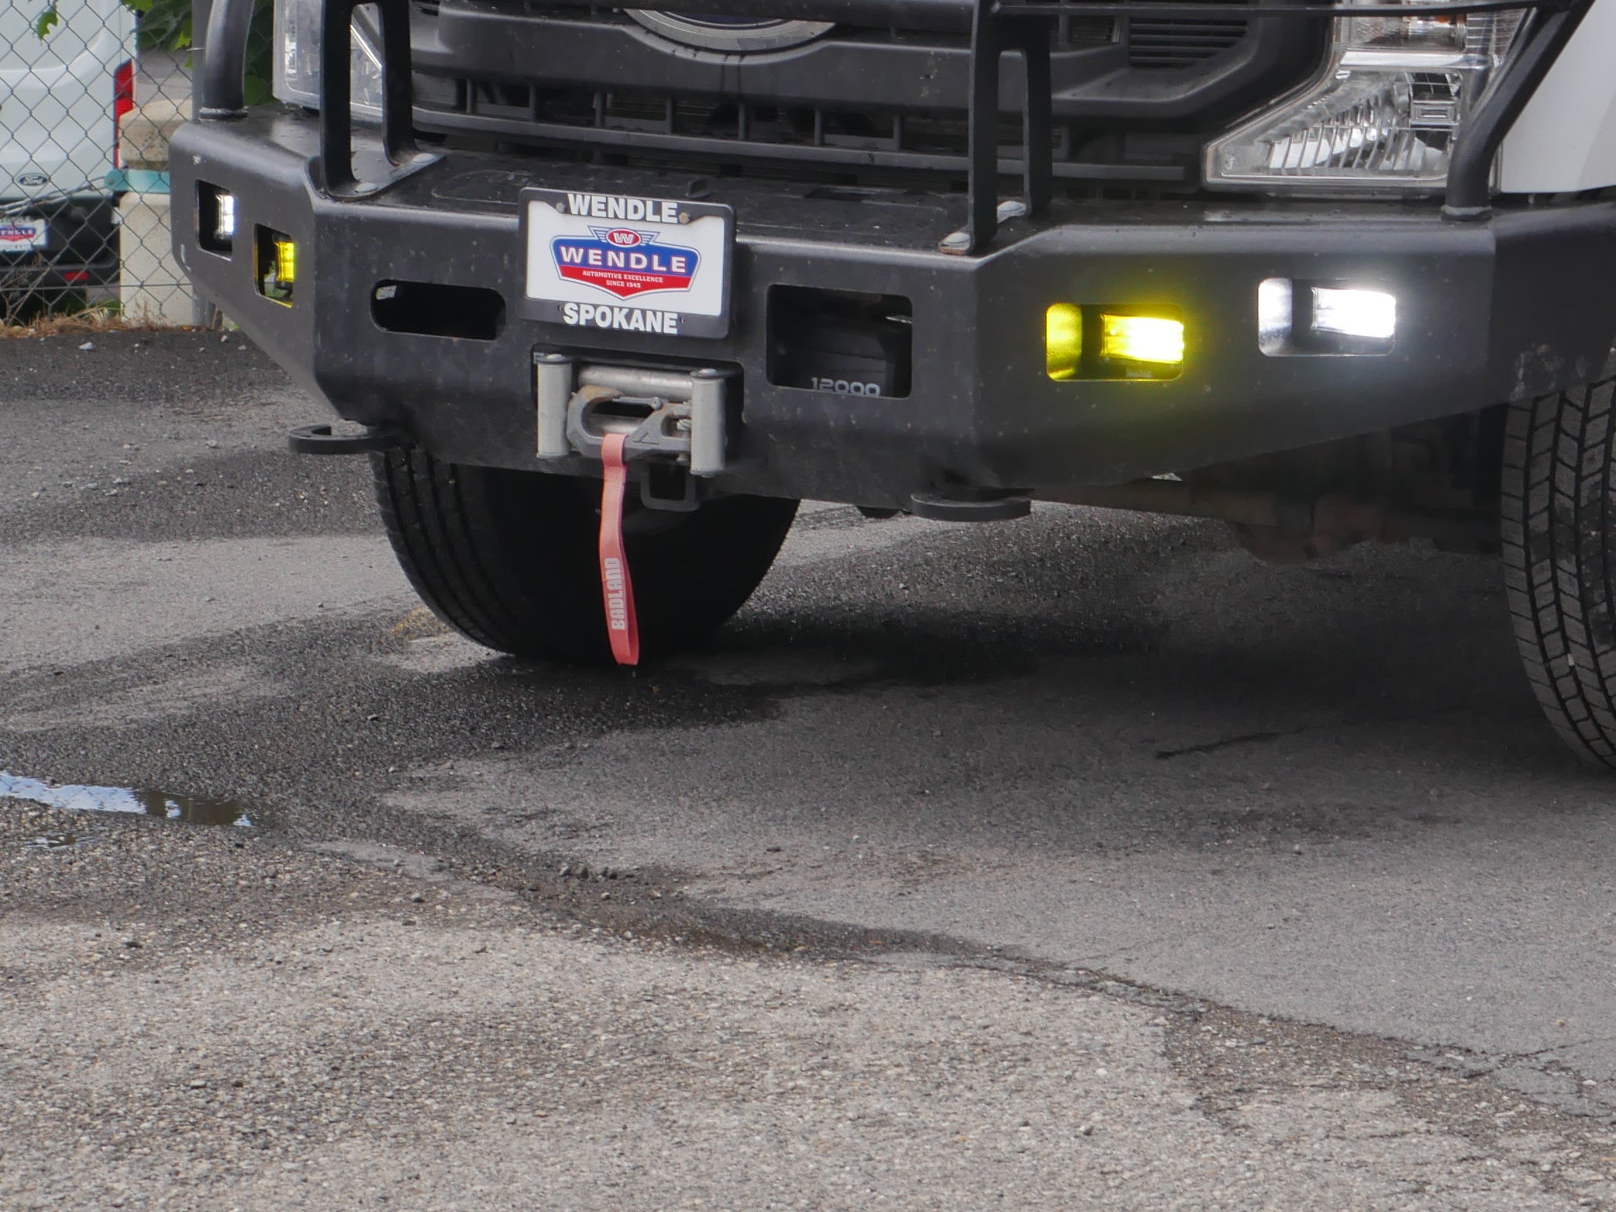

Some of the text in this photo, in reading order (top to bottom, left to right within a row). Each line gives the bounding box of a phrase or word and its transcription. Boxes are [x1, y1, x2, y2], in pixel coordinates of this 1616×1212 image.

[567, 193, 678, 224] WENDLE
[560, 246, 687, 273] WENDLE
[582, 269, 664, 283] AUTOMOTIVE EXCELLENCE
[562, 302, 678, 335] SPOKANE
[810, 376, 881, 397] 12000
[604, 557, 625, 630] BADLAND
